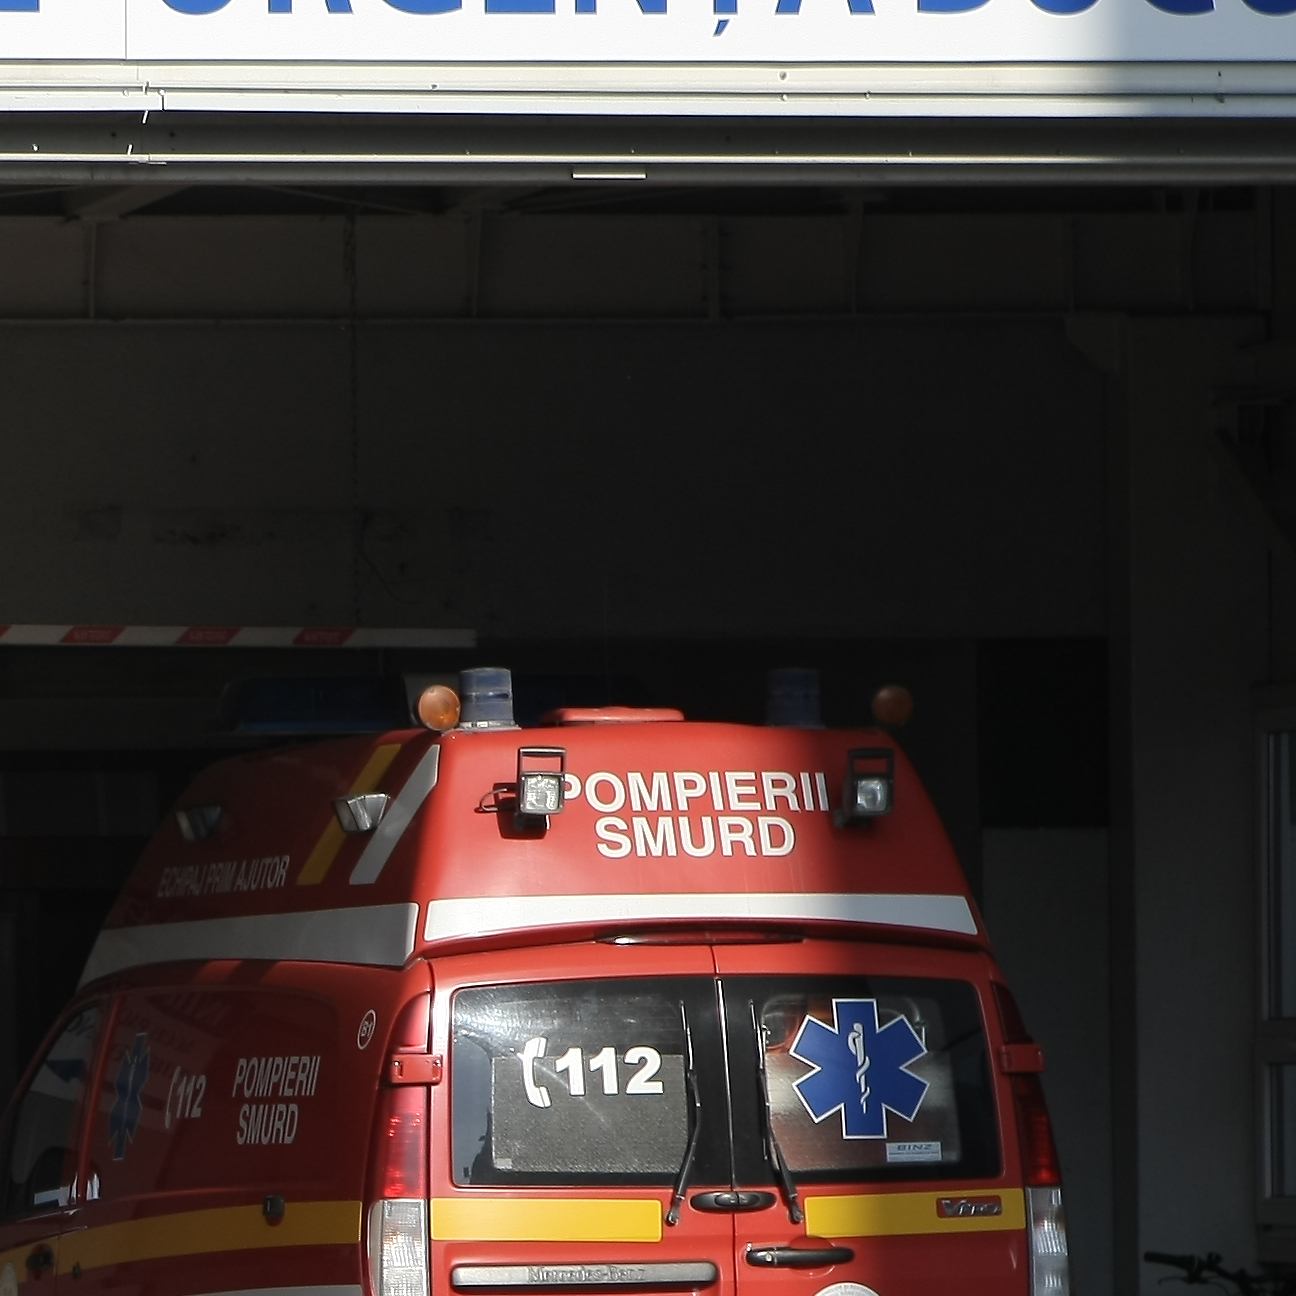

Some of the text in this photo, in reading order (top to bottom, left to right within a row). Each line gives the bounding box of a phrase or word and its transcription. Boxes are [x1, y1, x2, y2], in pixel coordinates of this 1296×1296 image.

[564, 770, 830, 813] POMPIERII
[595, 816, 797, 859] SMURD
[234, 855, 290, 892] AJUTOR
[232, 1055, 321, 1098] POMPIERII
[555, 1045, 665, 1096] 112
[175, 1075, 207, 1120] 112
[236, 1103, 299, 1146] SMURD
